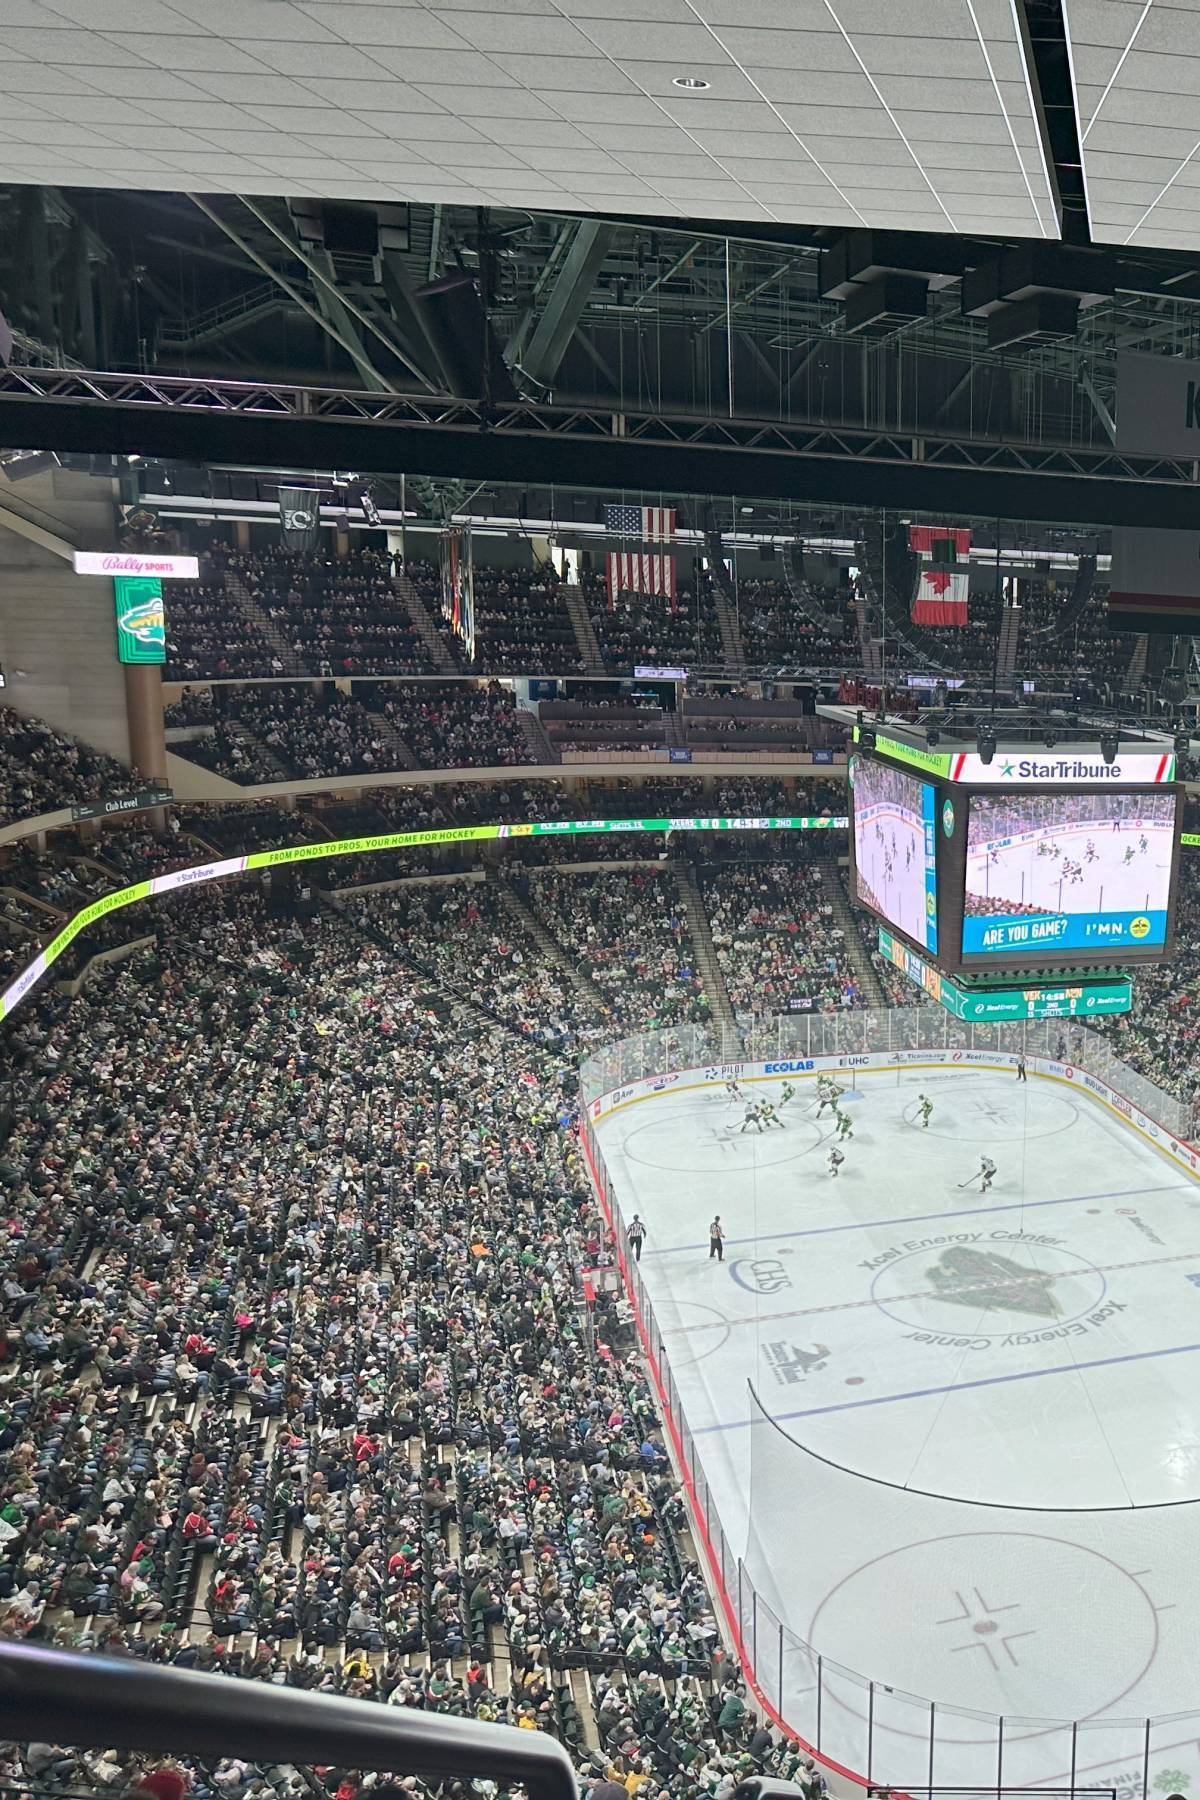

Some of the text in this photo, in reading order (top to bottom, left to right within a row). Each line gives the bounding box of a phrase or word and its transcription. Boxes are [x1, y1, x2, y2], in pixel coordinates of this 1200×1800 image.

[102, 556, 174, 573] Bally SPORTS
[1018, 761, 1121, 778] StarTribune
[106, 802, 120, 812] Club
[120, 798, 138, 809] Level
[270, 851, 292, 862] FROM
[294, 848, 324, 858] PONDS
[325, 846, 337, 854] TO
[366, 838, 389, 848] YOUR
[391, 834, 418, 844] HOME
[420, 833, 436, 842] FOR
[439, 830, 476, 840] HOCKEY
[983, 930, 1004, 946] ARE
[1008, 924, 1028, 942] YOU
[1032, 919, 1068, 938] GAME?
[1028, 1001, 1034, 1010] 0
[1070, 999, 1076, 1008] 0
[722, 1065, 744, 1074] PILOT
[765, 1061, 814, 1073] ECOLAB
[848, 1057, 869, 1066] UHC
[1084, 1077, 1095, 1088] BUD
[857, 1230, 1068, 1271] Xcel Energy Center
[751, 1260, 793, 1290] CHS
[902, 1300, 1128, 1351] Xcel Energy Center
